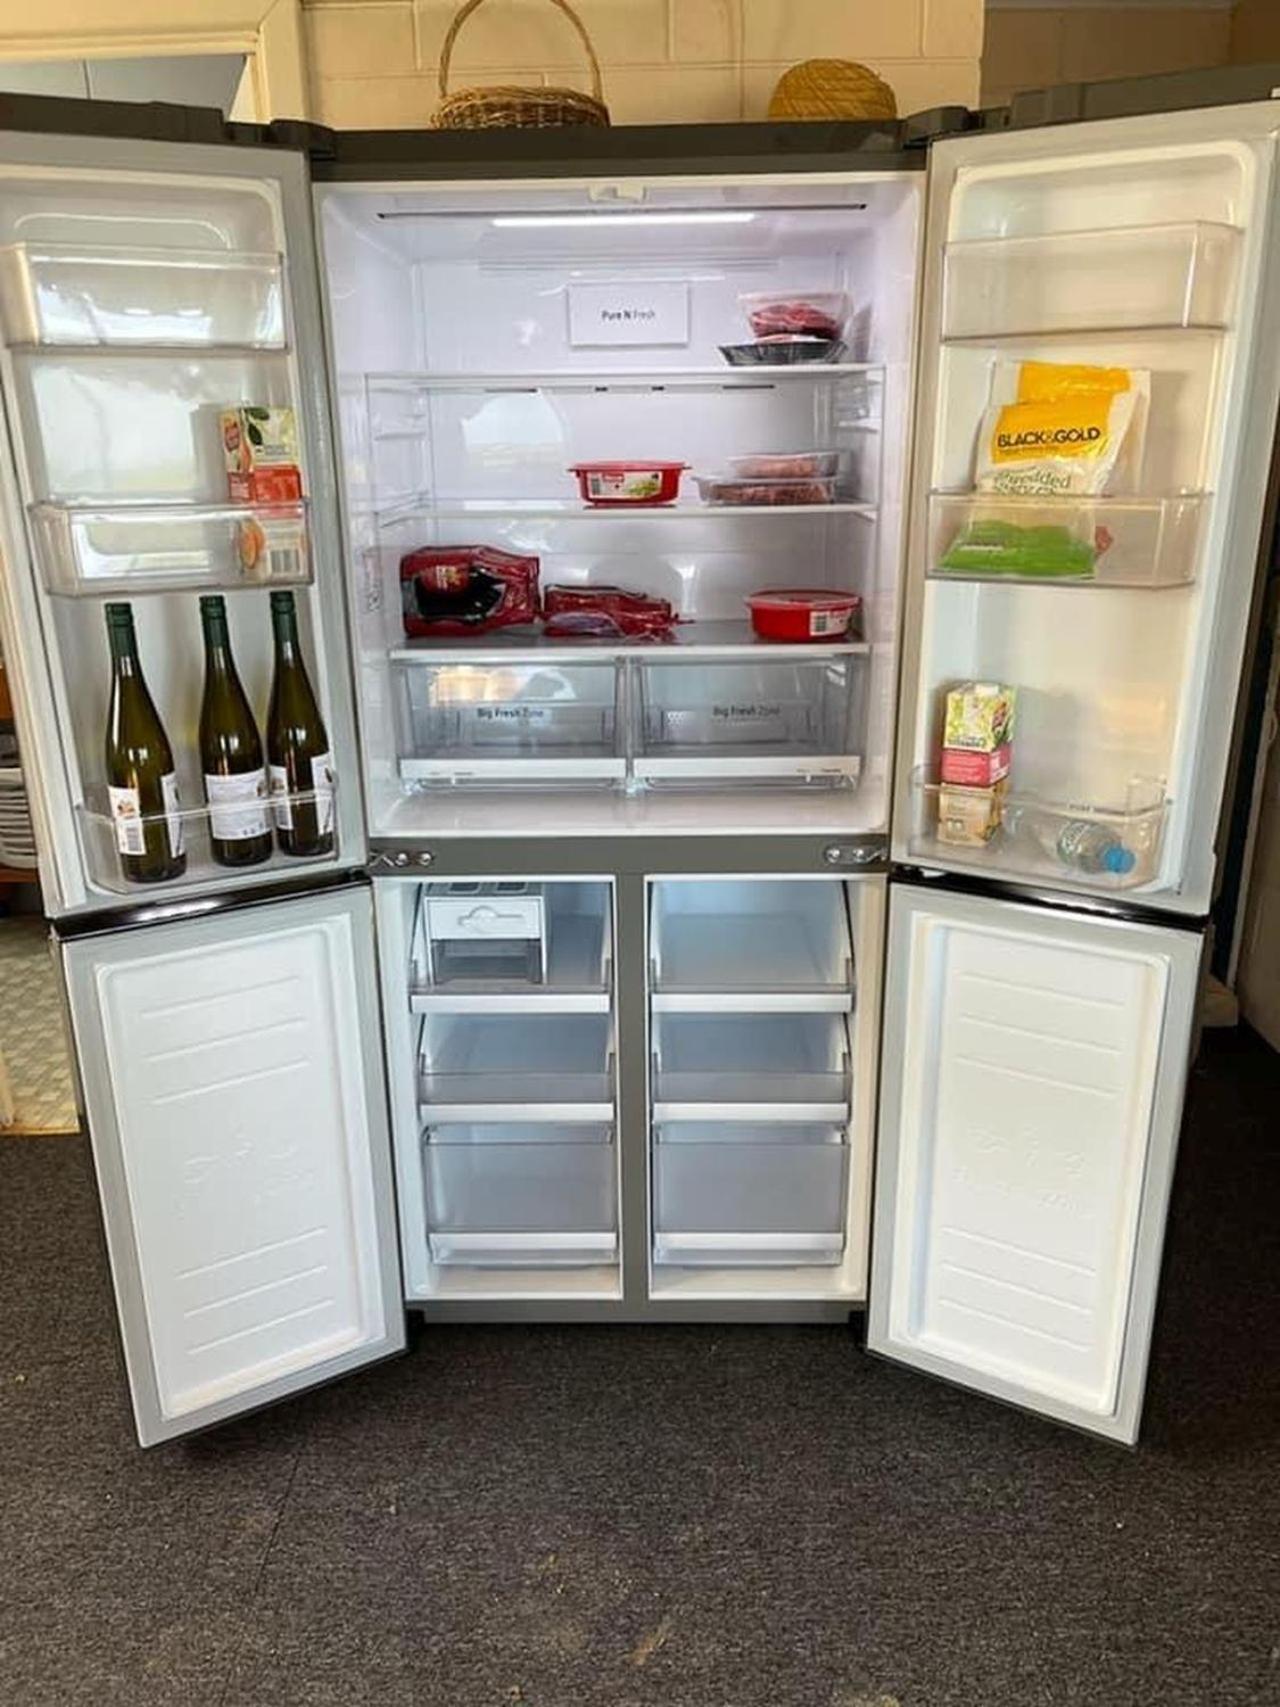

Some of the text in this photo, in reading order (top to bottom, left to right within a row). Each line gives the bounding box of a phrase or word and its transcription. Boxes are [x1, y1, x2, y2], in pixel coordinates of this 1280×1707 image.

[477, 707, 493, 719] Big
[495, 707, 520, 718] Fresh
[713, 705, 729, 719] Big
[731, 704, 756, 717] Fresh
